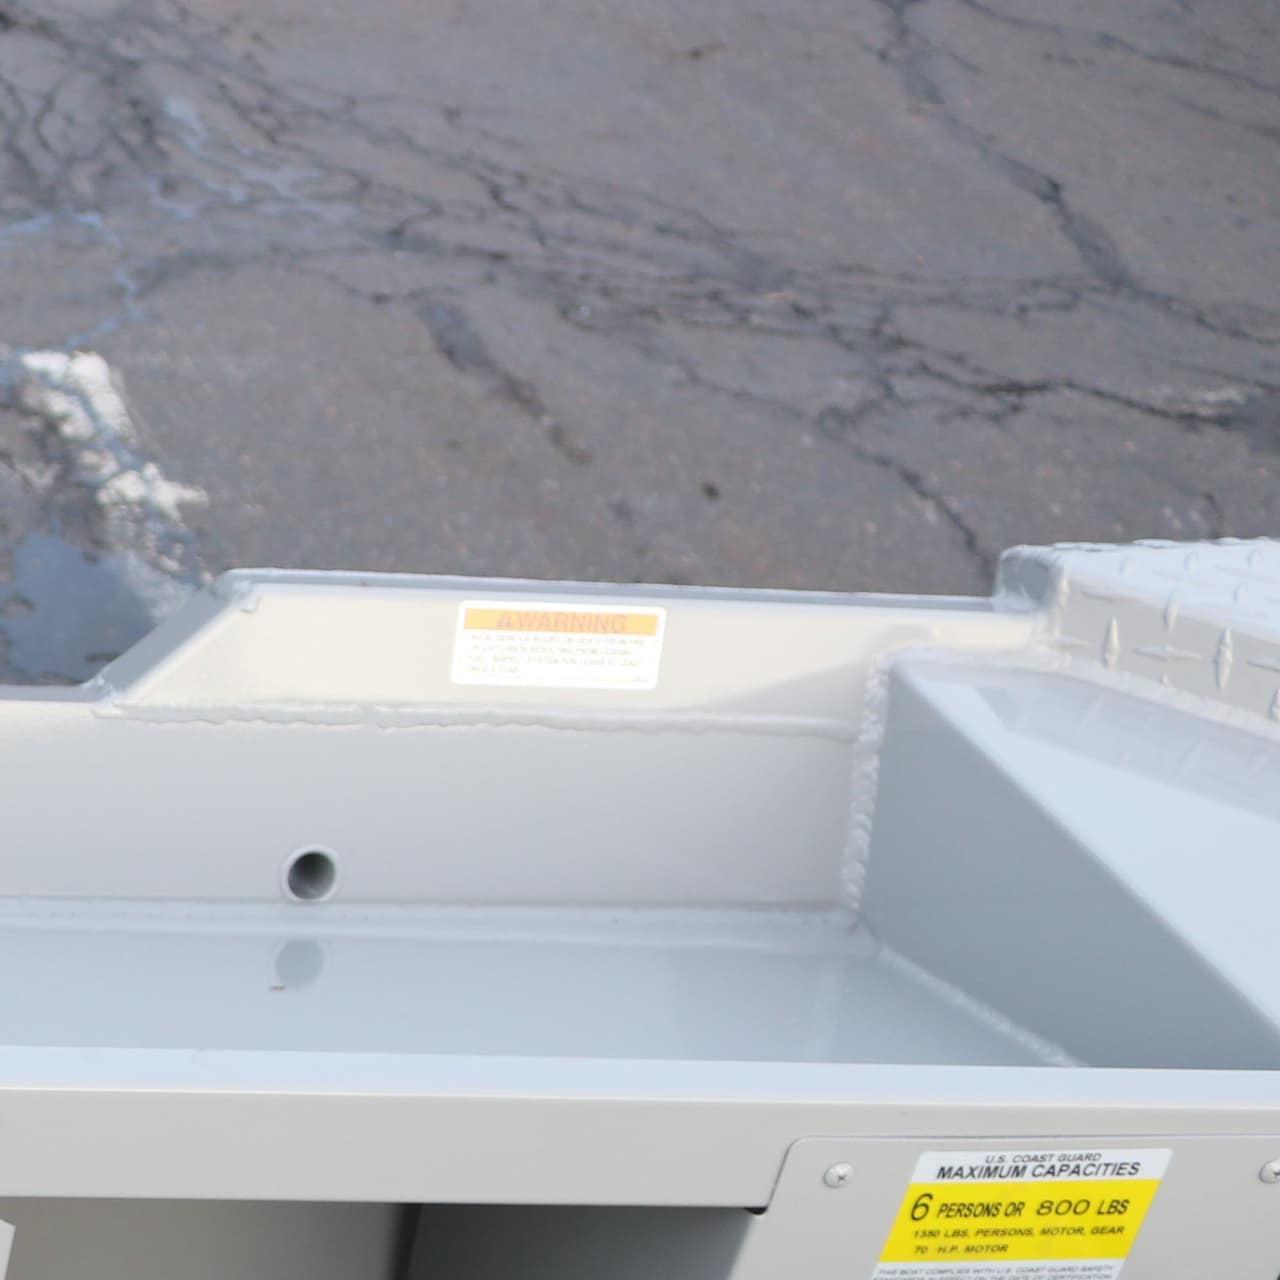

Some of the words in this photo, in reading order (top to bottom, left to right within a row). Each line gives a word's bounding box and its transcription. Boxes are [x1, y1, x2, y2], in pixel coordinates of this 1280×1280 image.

[517, 611, 627, 634] WARNING
[985, 1154, 1008, 1164] U.S.
[1011, 1153, 1055, 1164] COAST
[1057, 1152, 1102, 1163] GUARD
[936, 1164, 1028, 1180] MAXIMUM
[1031, 1162, 1141, 1178] CAPACITIES
[910, 1193, 934, 1222] 6
[936, 1202, 1003, 1219] PERSONS
[1004, 1201, 1026, 1217] OR
[1035, 1199, 1091, 1216] 800
[1096, 1198, 1130, 1216] LBS
[1090, 1225, 1126, 1235] GEAR
[914, 1245, 929, 1255] 70
[963, 1244, 1009, 1254] MOTOR
